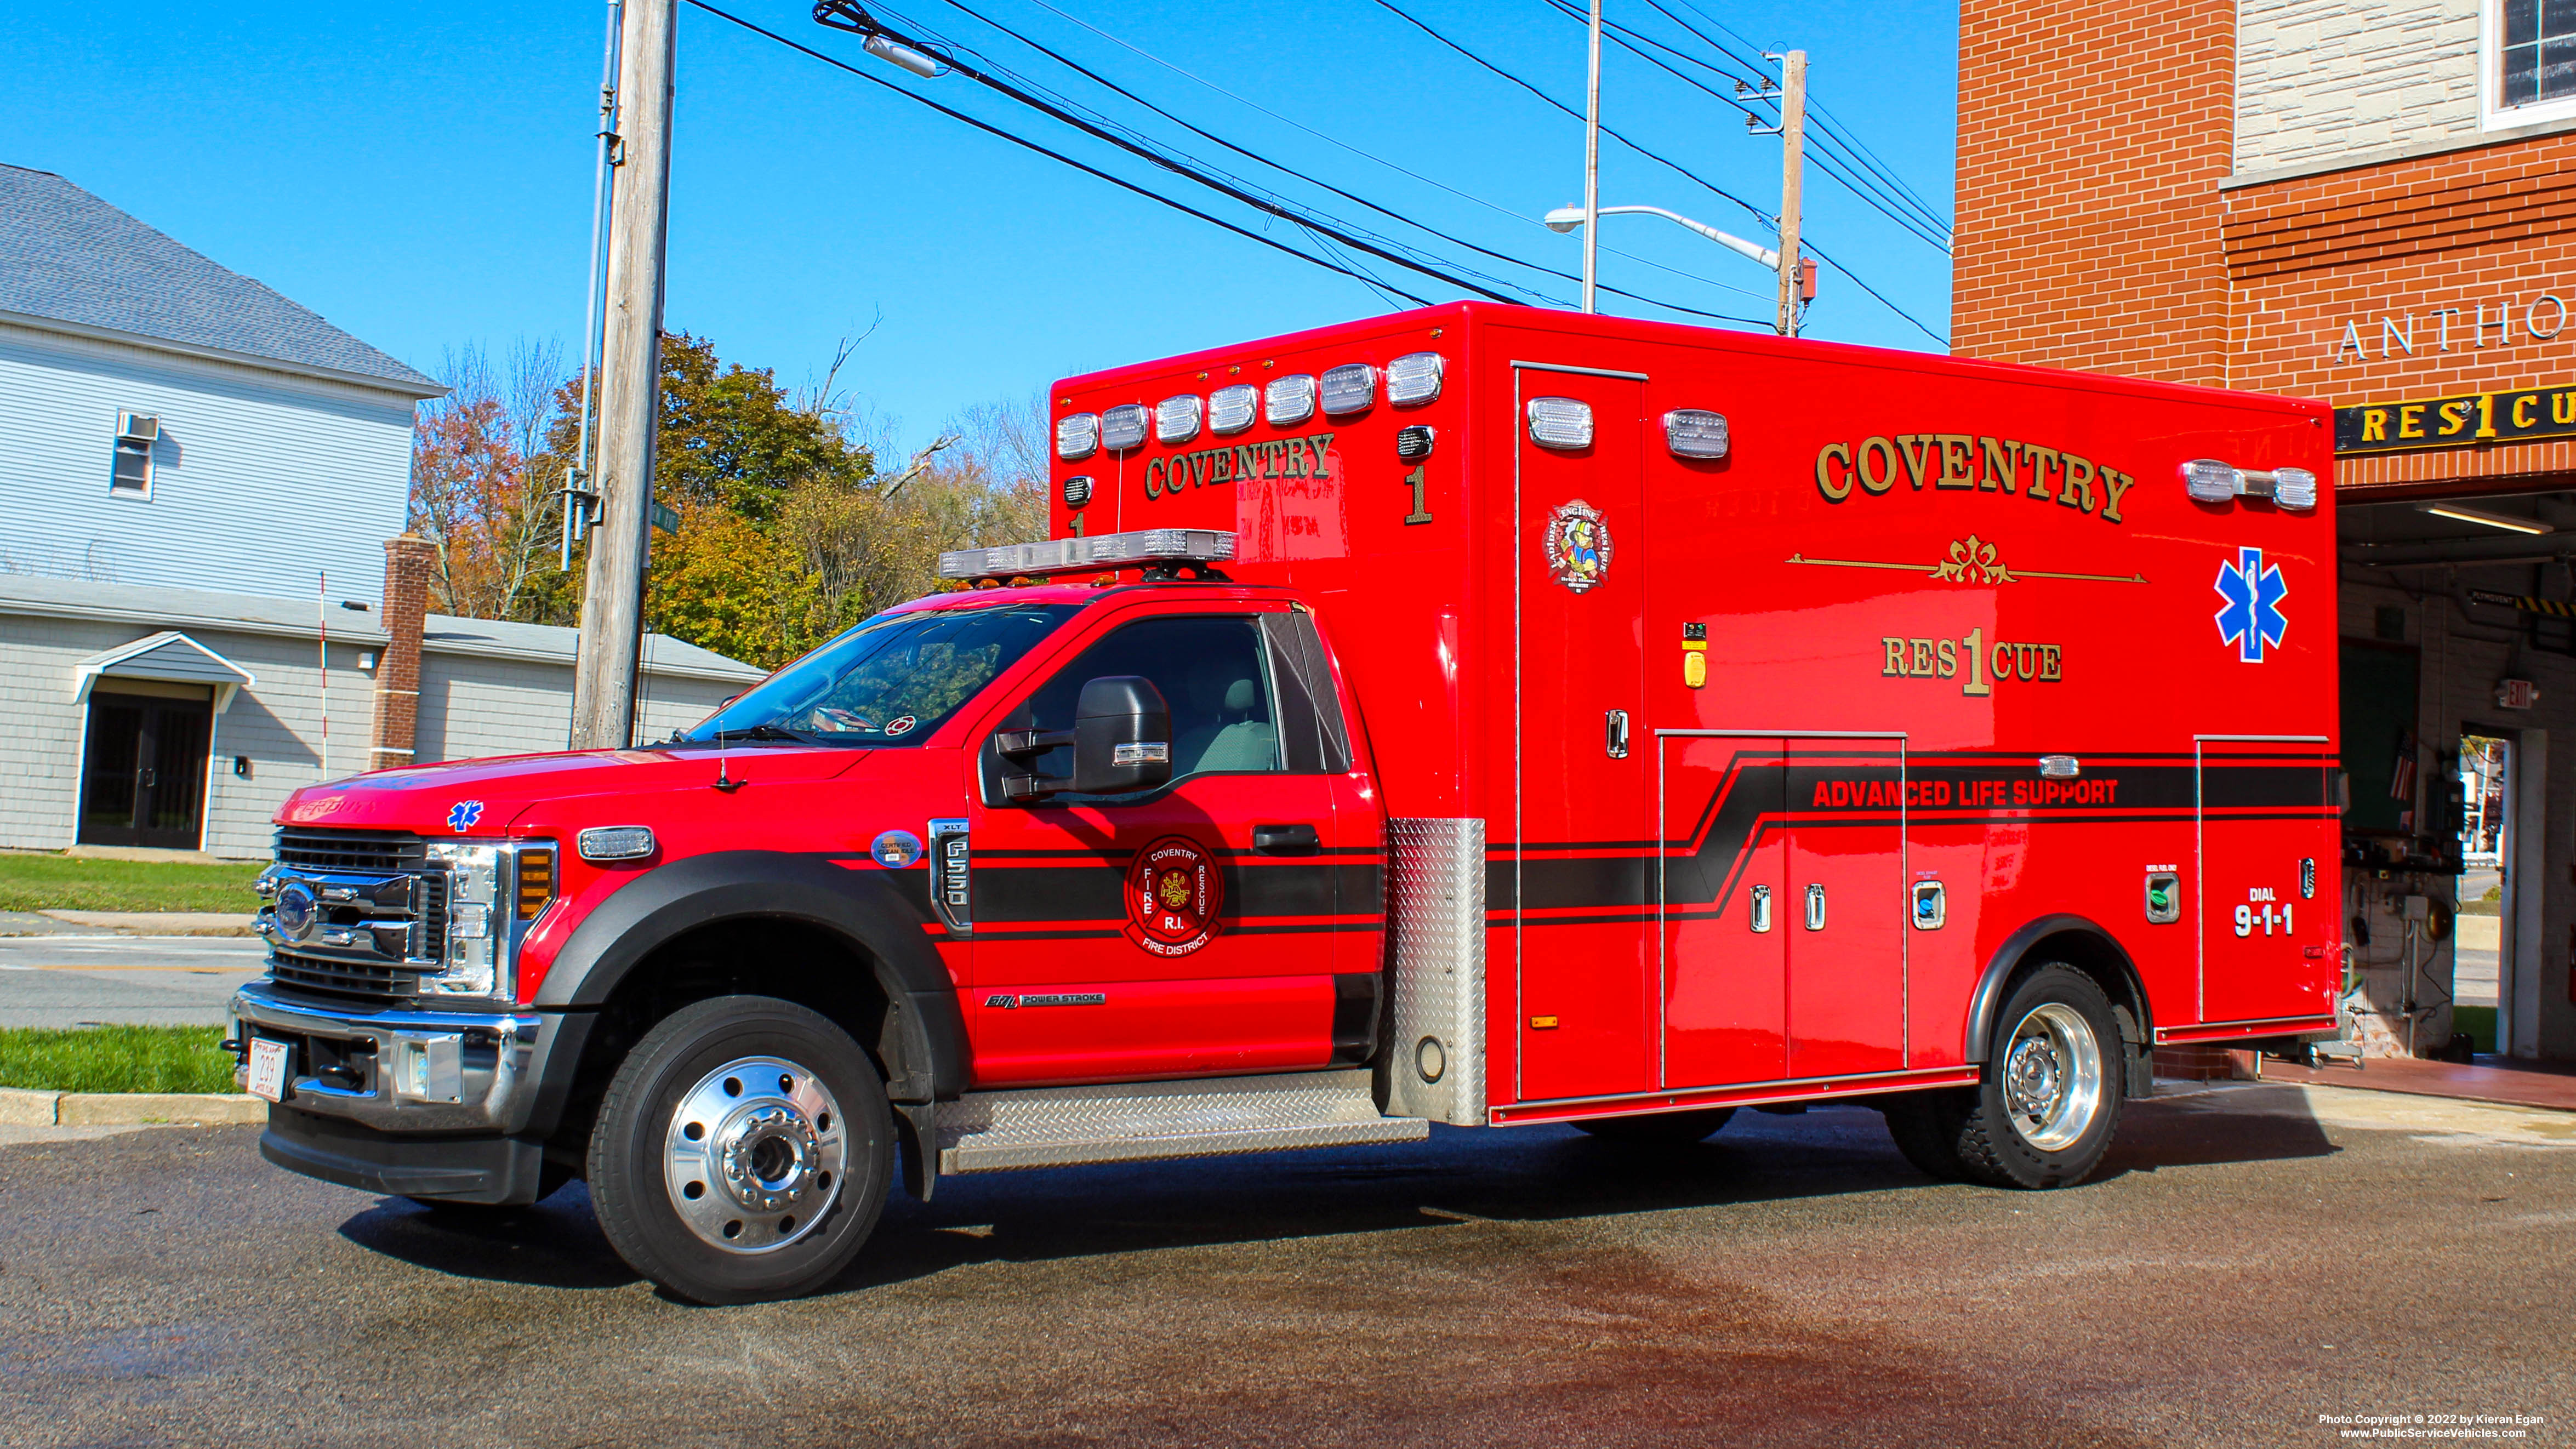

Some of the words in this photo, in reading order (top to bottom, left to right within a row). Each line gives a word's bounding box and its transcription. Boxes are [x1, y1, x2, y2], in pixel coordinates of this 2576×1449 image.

[2334, 295, 2567, 363] ANTHO
[1145, 433, 1334, 500] COVENTRY
[1816, 433, 2134, 523] COVENTRY
[1405, 465, 1432, 526] 1
[2510, 681, 2529, 706] EXIT
[1813, 780, 1951, 807] ADVANCED
[1959, 780, 2006, 806] LIFE
[2013, 779, 2119, 806] SUPPORT
[1151, 848, 1198, 862] COVENTRY
[1144, 868, 1153, 915] FIRE
[2249, 887, 2276, 902] DIAL
[1165, 916, 1184, 930] R.I.
[2235, 903, 2293, 938] 9-1-1
[1142, 937, 1165, 954] FIRE
[1166, 931, 1209, 955] DISTRICT
[1023, 995, 1060, 1003] POWER
[1062, 993, 1103, 1002] STROKE
